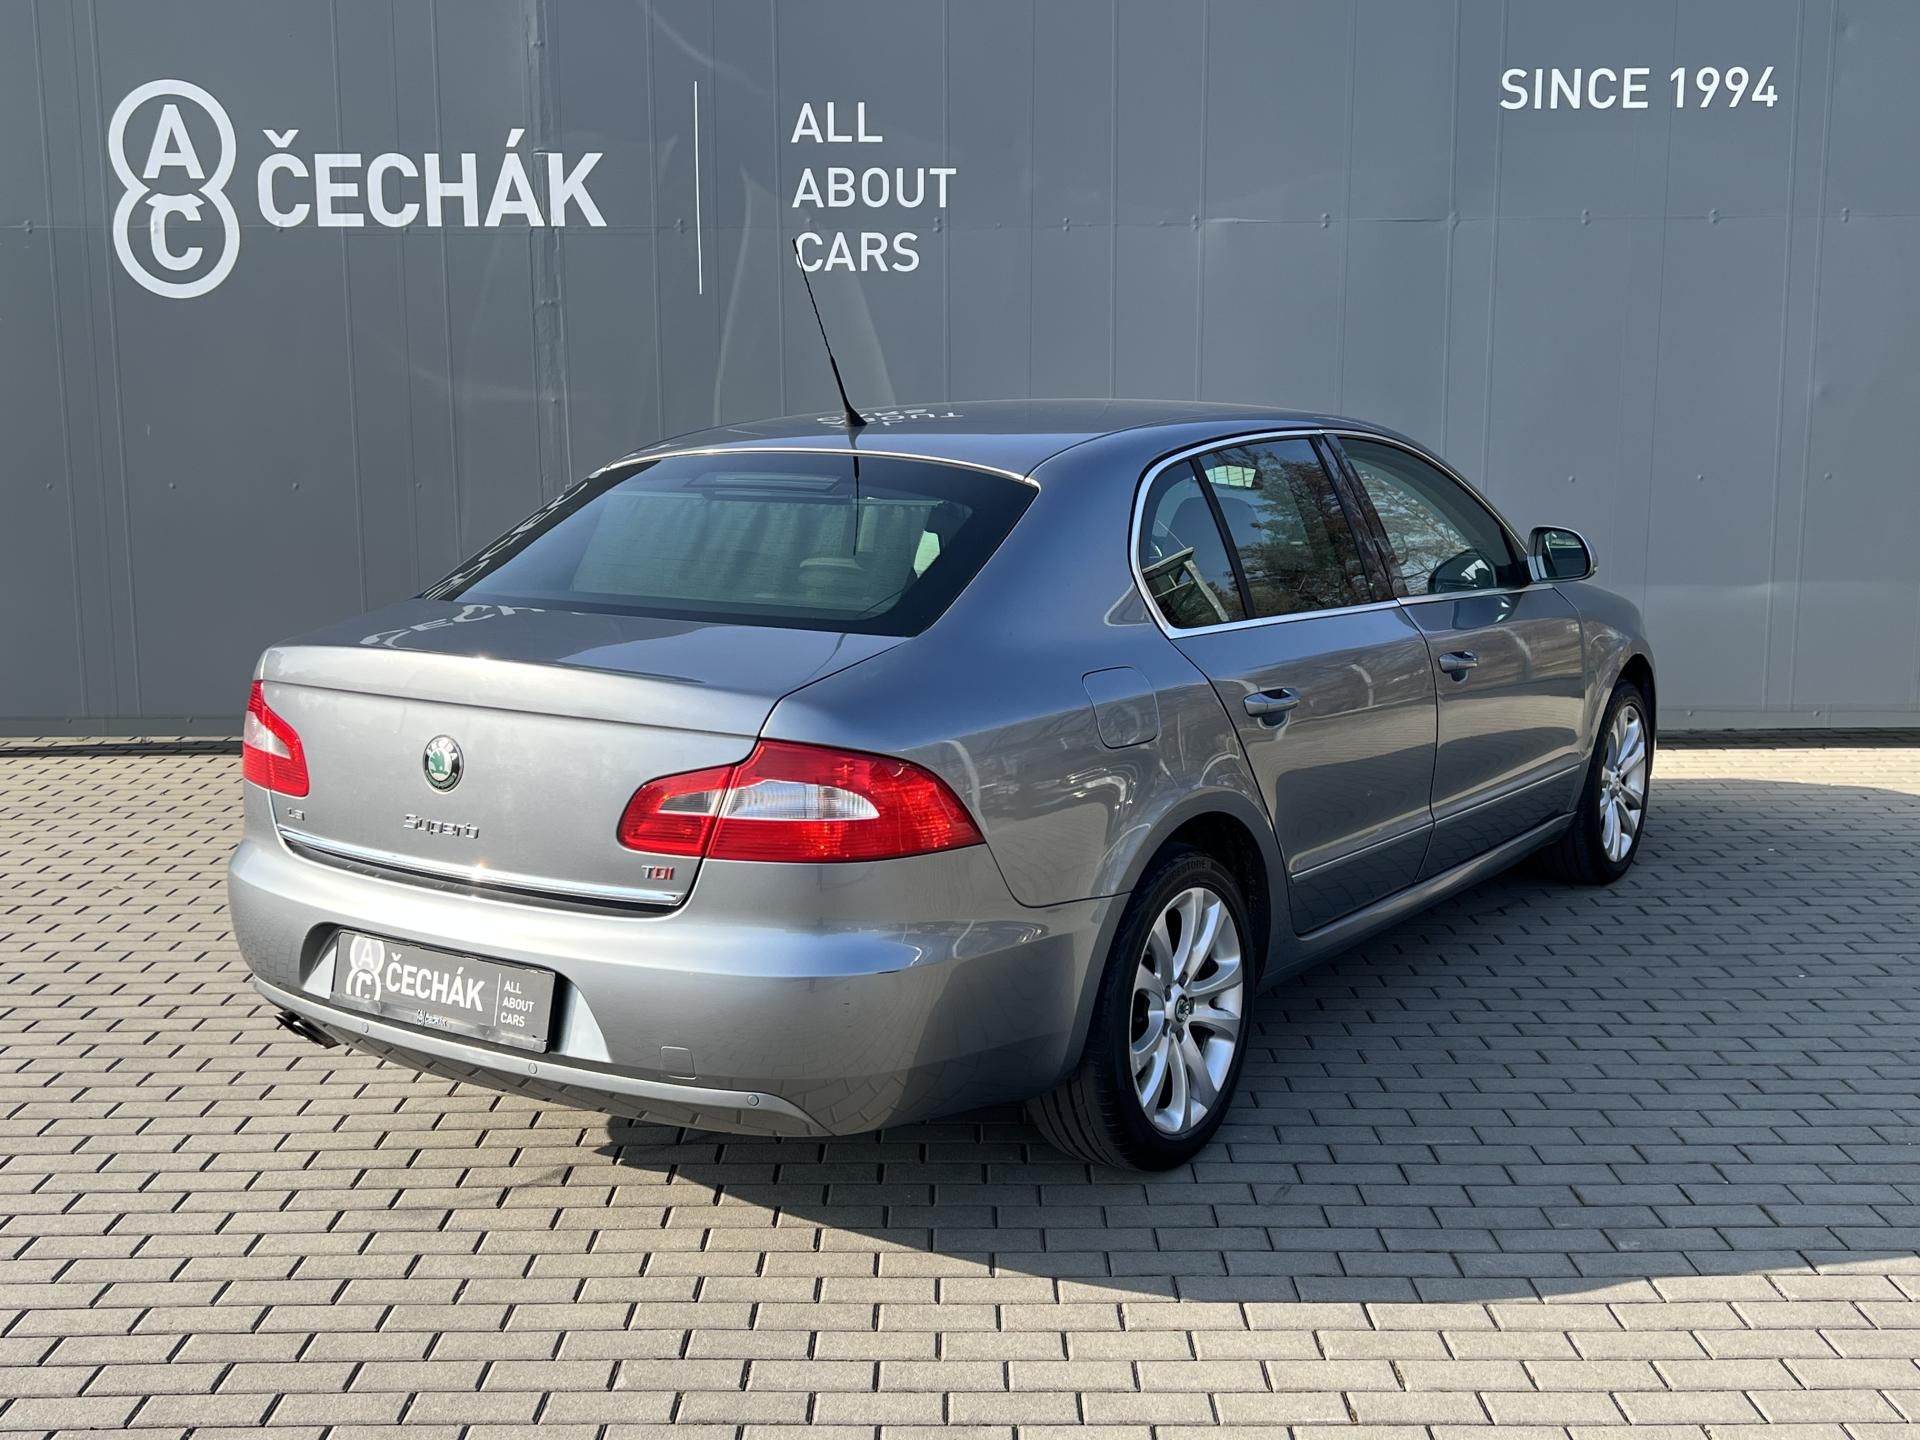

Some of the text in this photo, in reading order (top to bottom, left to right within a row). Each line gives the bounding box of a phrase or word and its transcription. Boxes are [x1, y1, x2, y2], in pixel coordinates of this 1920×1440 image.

[1500, 66, 1778, 110] SINCE 1994
[142, 104, 205, 180] A
[791, 101, 883, 143] ALL
[257, 128, 608, 228] ČECHÁK
[791, 167, 957, 208] ABOUT
[795, 231, 920, 272] CARS
[402, 812, 480, 840] Superb
[640, 864, 675, 881] TDI
[385, 952, 486, 1012] ČECHÁK
[503, 979, 523, 995] ALL
[500, 1011, 526, 1028] CARS
[502, 996, 535, 1013] ABOUT
